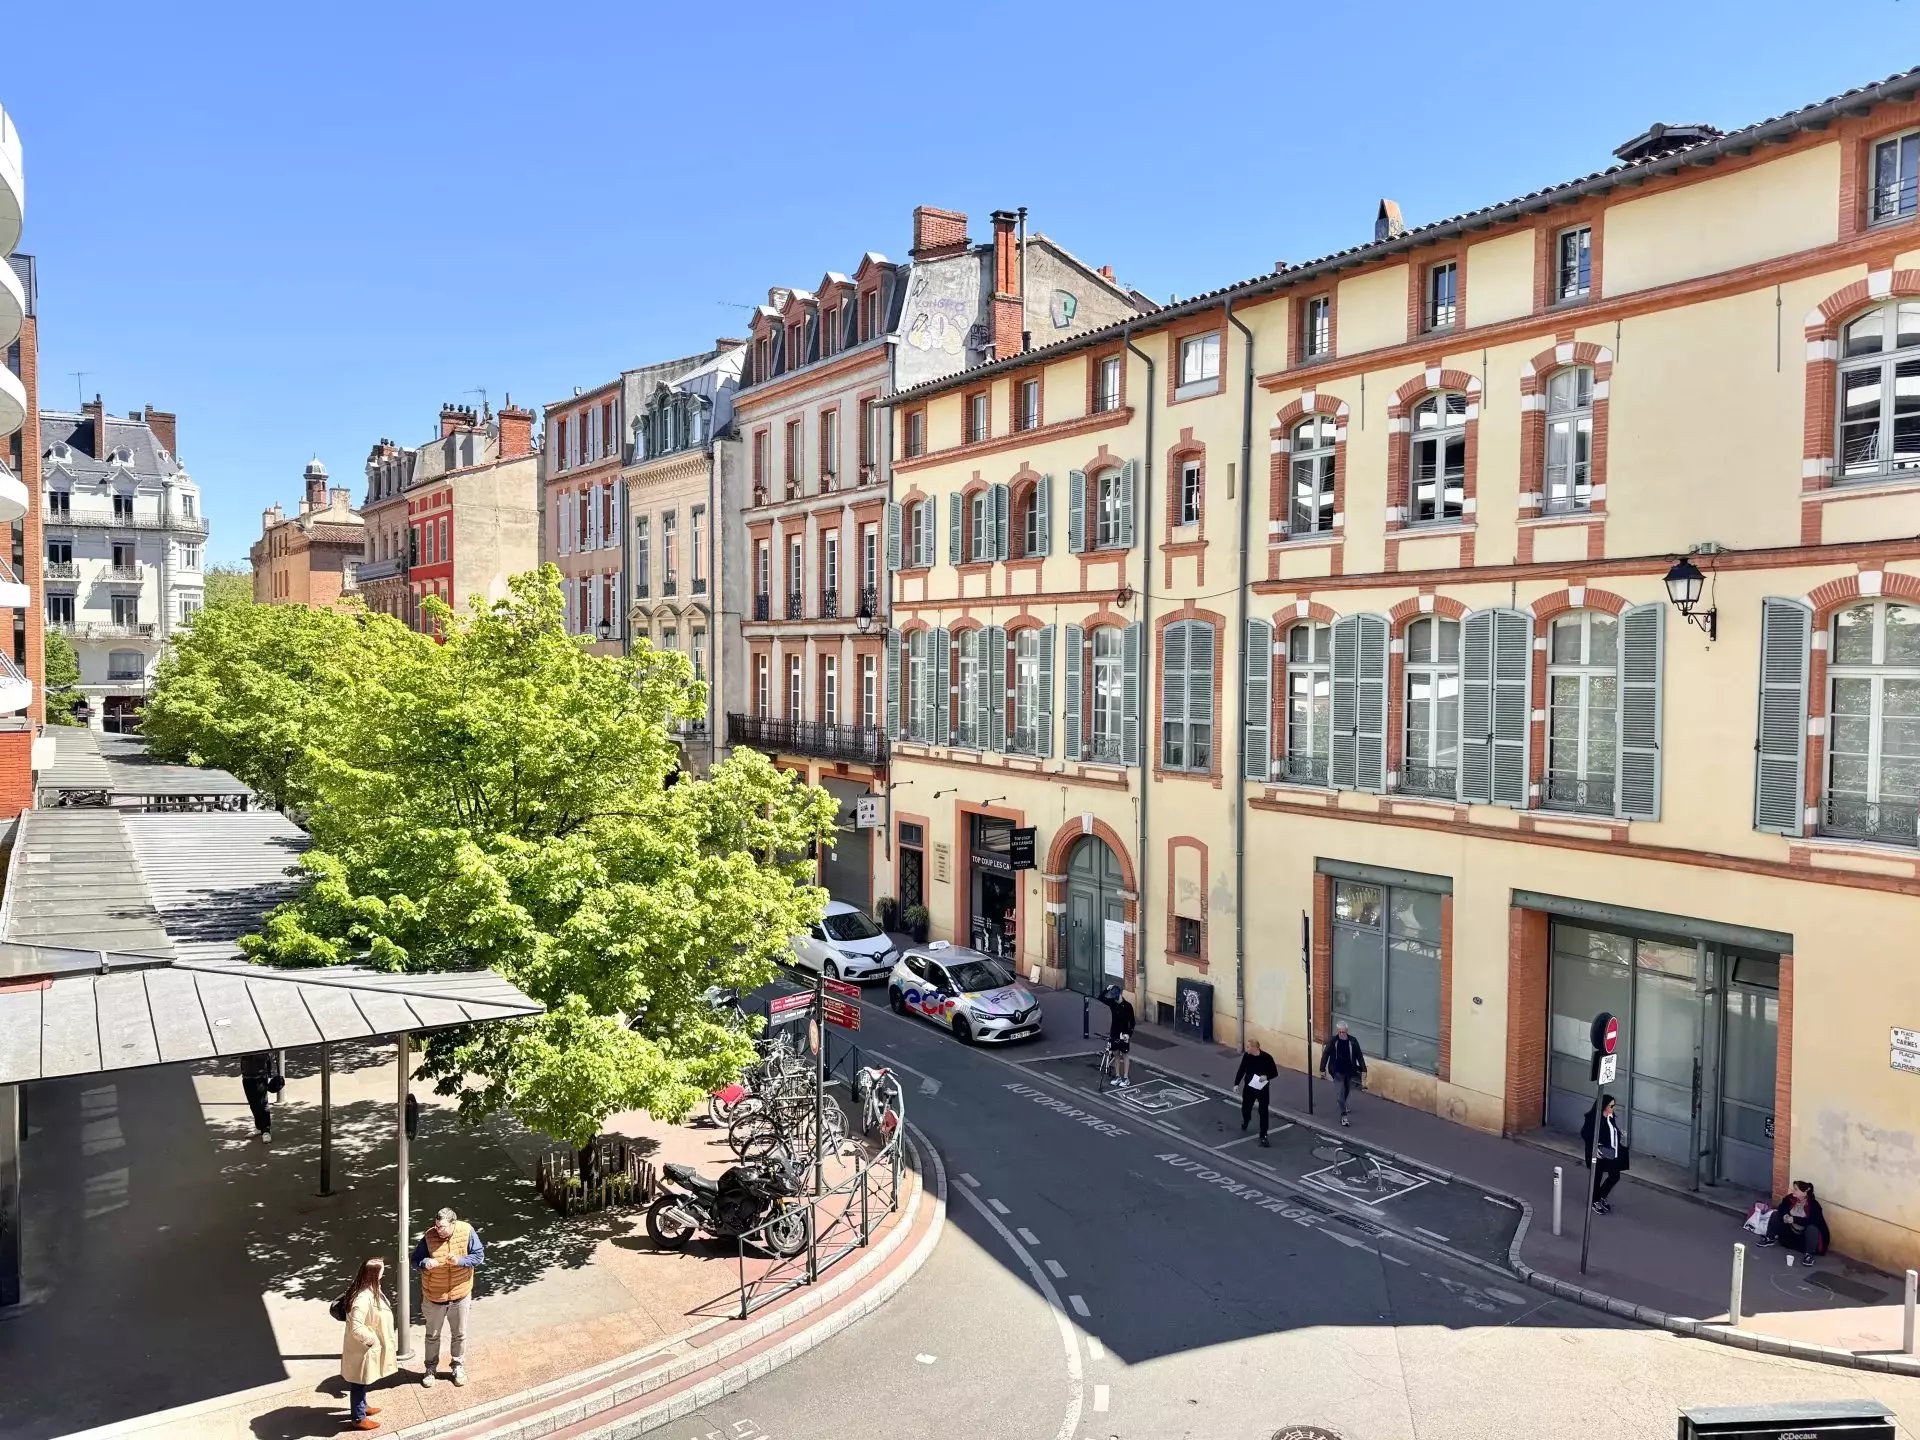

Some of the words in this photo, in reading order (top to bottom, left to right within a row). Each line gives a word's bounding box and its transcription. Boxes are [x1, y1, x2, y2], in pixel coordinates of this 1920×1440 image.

[972, 855, 981, 863] TOP
[981, 857, 993, 866] COUP
[993, 860, 1002, 869] LES
[1900, 1030, 1914, 1038] PLACE
[1896, 1038, 1918, 1048] CARMES
[1001, 1083, 1131, 1137] AUTOPARTAGE
[1154, 1153, 1326, 1227] AUTOPARTAGE
[1778, 1432, 1818, 1440] JCDecaux
